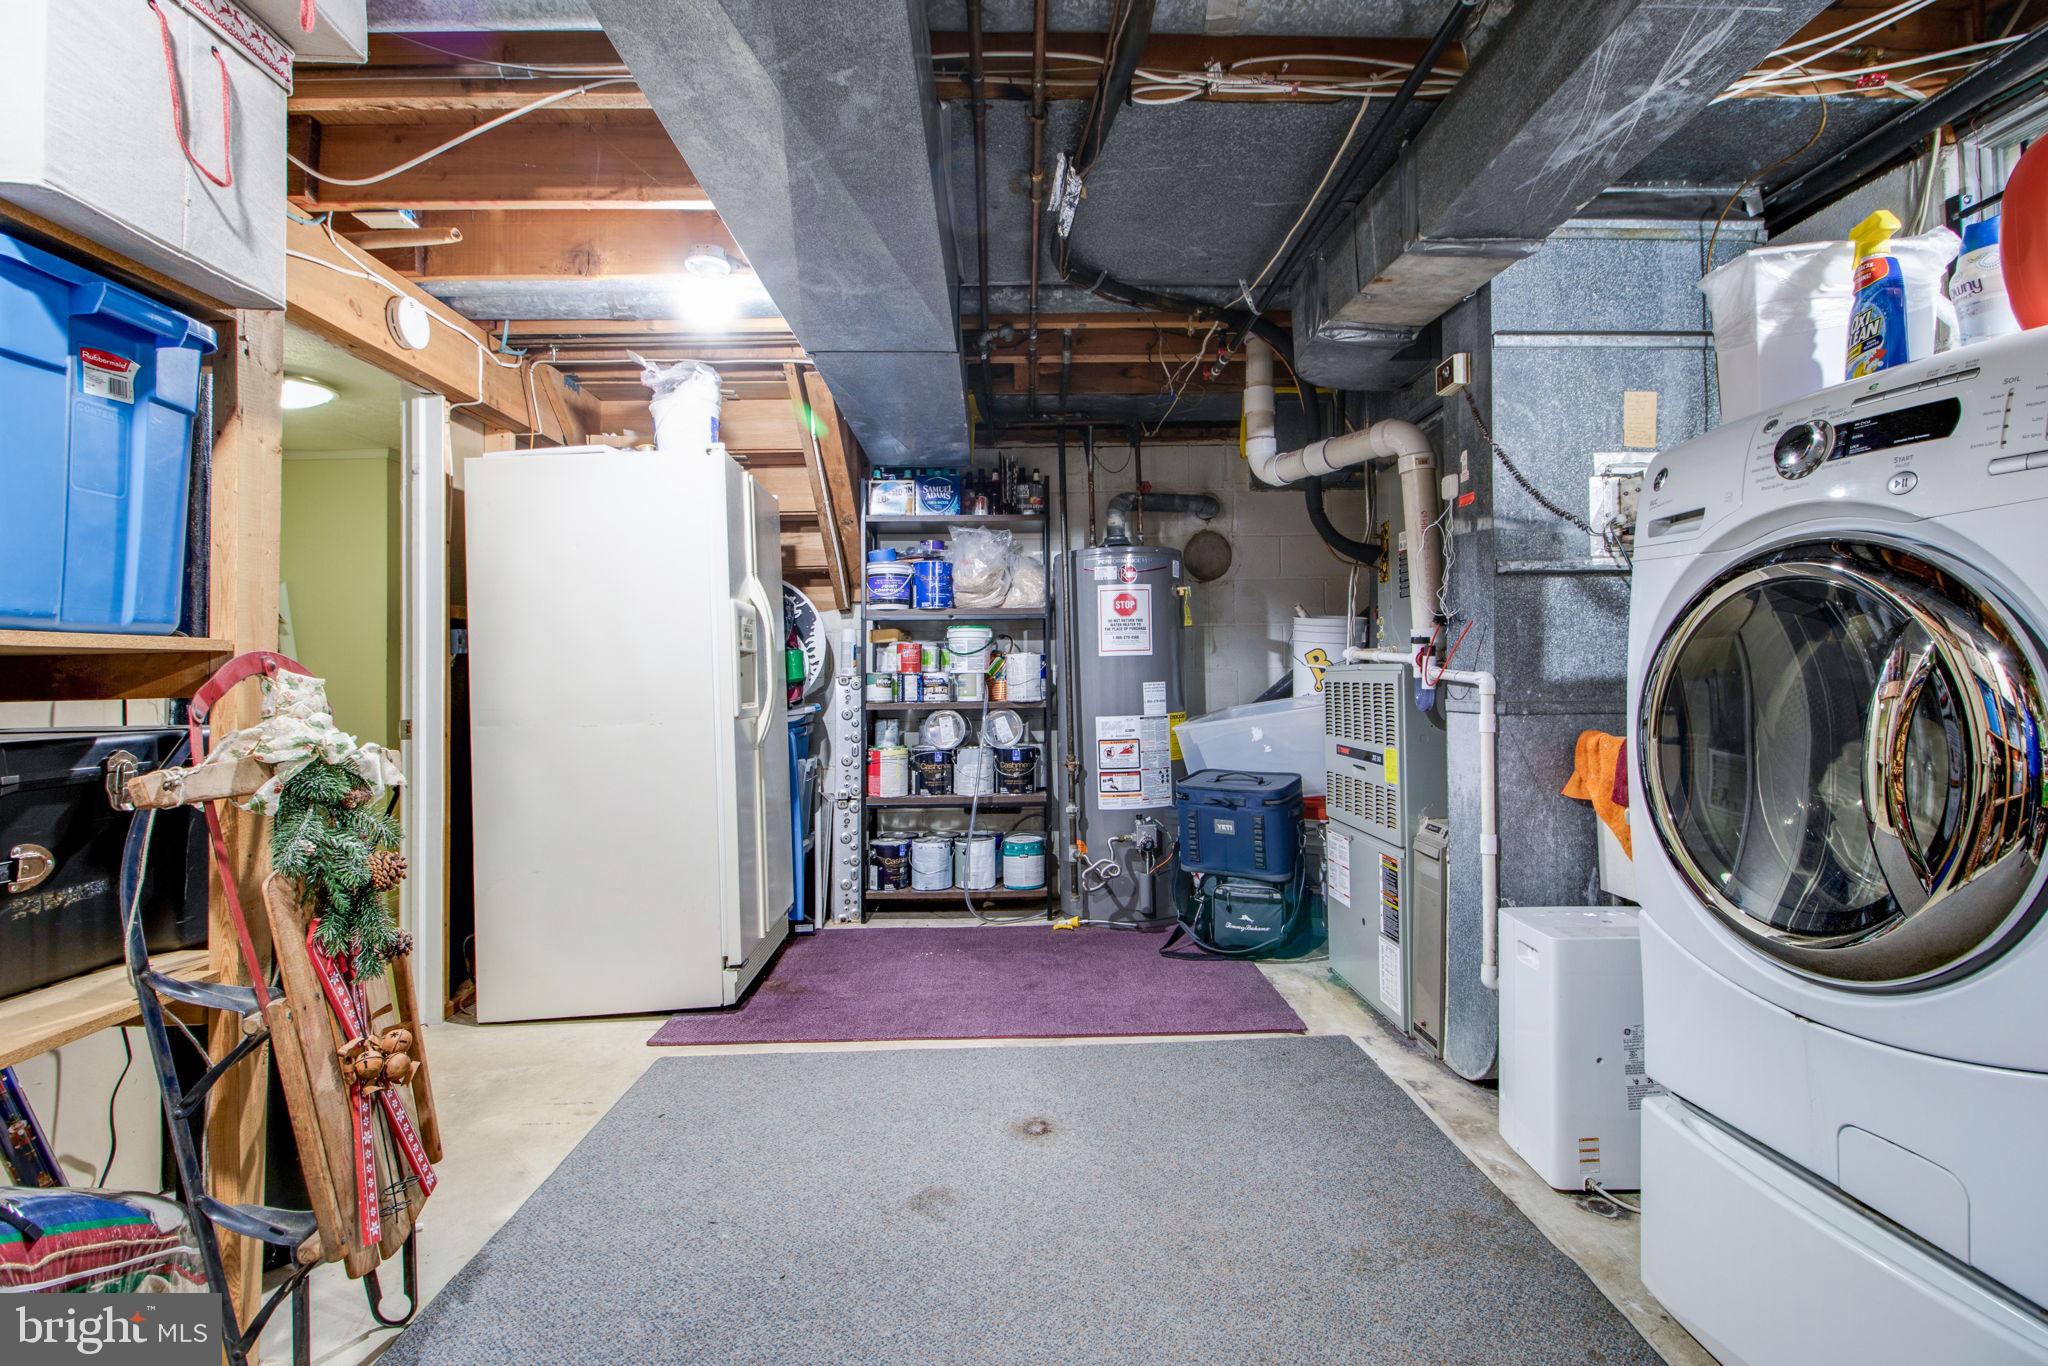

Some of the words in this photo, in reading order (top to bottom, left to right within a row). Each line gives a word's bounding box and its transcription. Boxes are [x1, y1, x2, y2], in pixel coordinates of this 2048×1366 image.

[1851, 310, 1872, 334] OXI
[82, 350, 128, 369] Rubbermaid
[2003, 375, 2021, 385] SOIL
[1893, 454, 1914, 464] START
[922, 484, 955, 494] SAMUEL
[924, 492, 951, 500] ADAMS
[1115, 600, 1135, 609] STOP
[1216, 823, 1233, 832] YETI
[1225, 921, 1246, 932] Tommy
